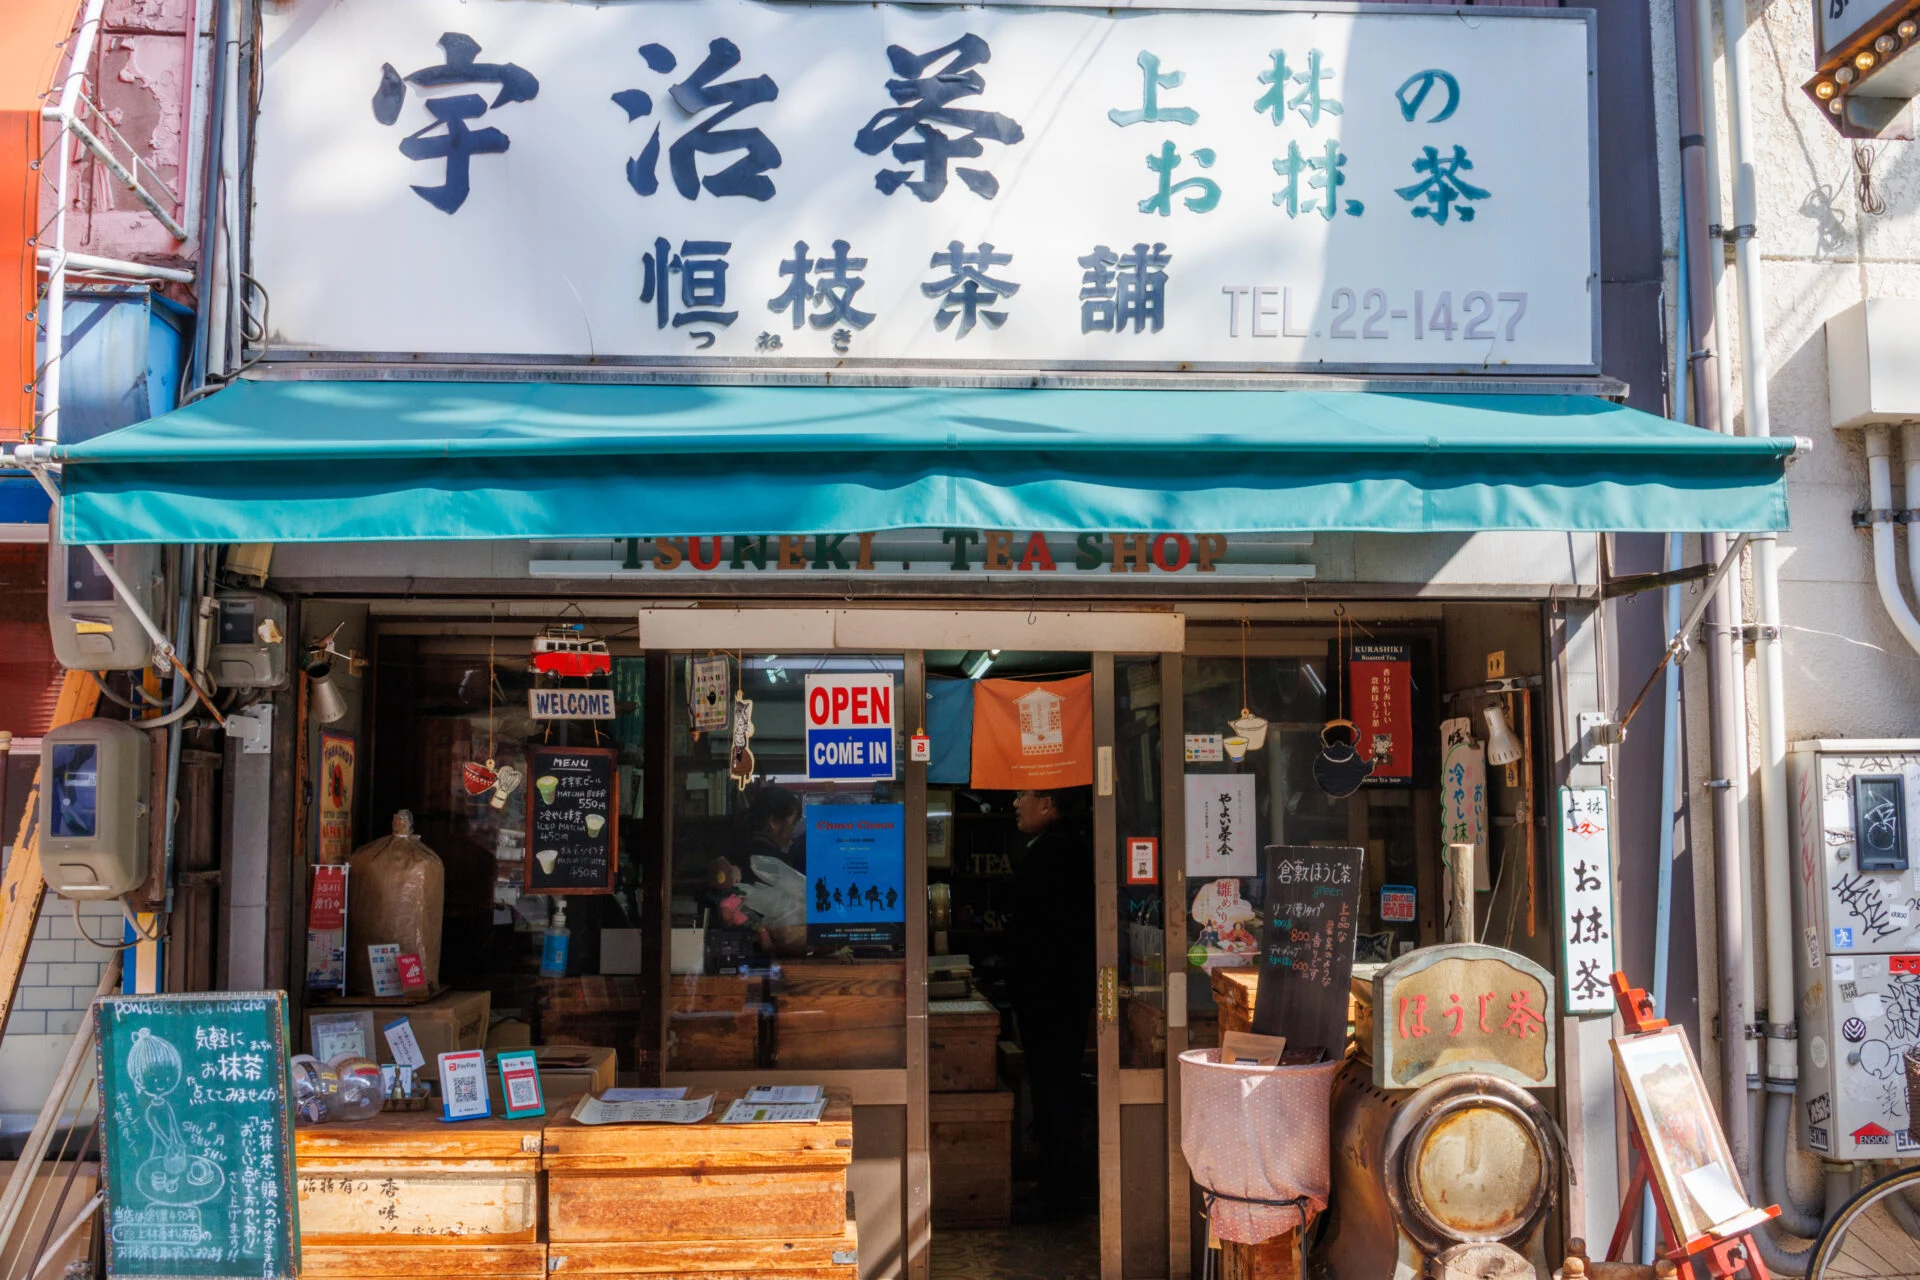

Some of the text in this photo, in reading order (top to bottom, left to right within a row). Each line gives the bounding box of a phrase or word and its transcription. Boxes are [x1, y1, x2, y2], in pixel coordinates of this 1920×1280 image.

[1108, 48, 1461, 127] 上林の
[372, 32, 1025, 215] 宇治茶
[1138, 139, 1492, 225] お抹茶
[614, 530, 1229, 573] TSUNEKI TEA SHOP
[1355, 645, 1403, 654] KURASHIKI
[1361, 654, 1385, 662] Roasted
[536, 692, 611, 716] WELCOME
[809, 685, 890, 726] OPEN
[553, 758, 589, 768] MENU
[813, 741, 887, 766] COME IN
[816, 819, 895, 831] Choco Choco
[1216, 793, 1234, 856] やよい茶会
[970, 853, 1014, 875] TEA
[1278, 859, 1352, 885] 倉敷ほうじ茶
[1312, 886, 1343, 898] green
[1569, 859, 1612, 1001] お抹茶
[114, 1000, 182, 1022] powdered
[216, 999, 267, 1013] matcha
[1399, 990, 1545, 1040] ほうじ茶
[195, 1025, 245, 1051] 気軽に
[201, 1051, 264, 1081] お抹茶
[457, 1062, 477, 1070] PayPay
[182, 1121, 203, 1134] SHU
[190, 1134, 211, 1147] SHU
[202, 1147, 228, 1162] SHU
